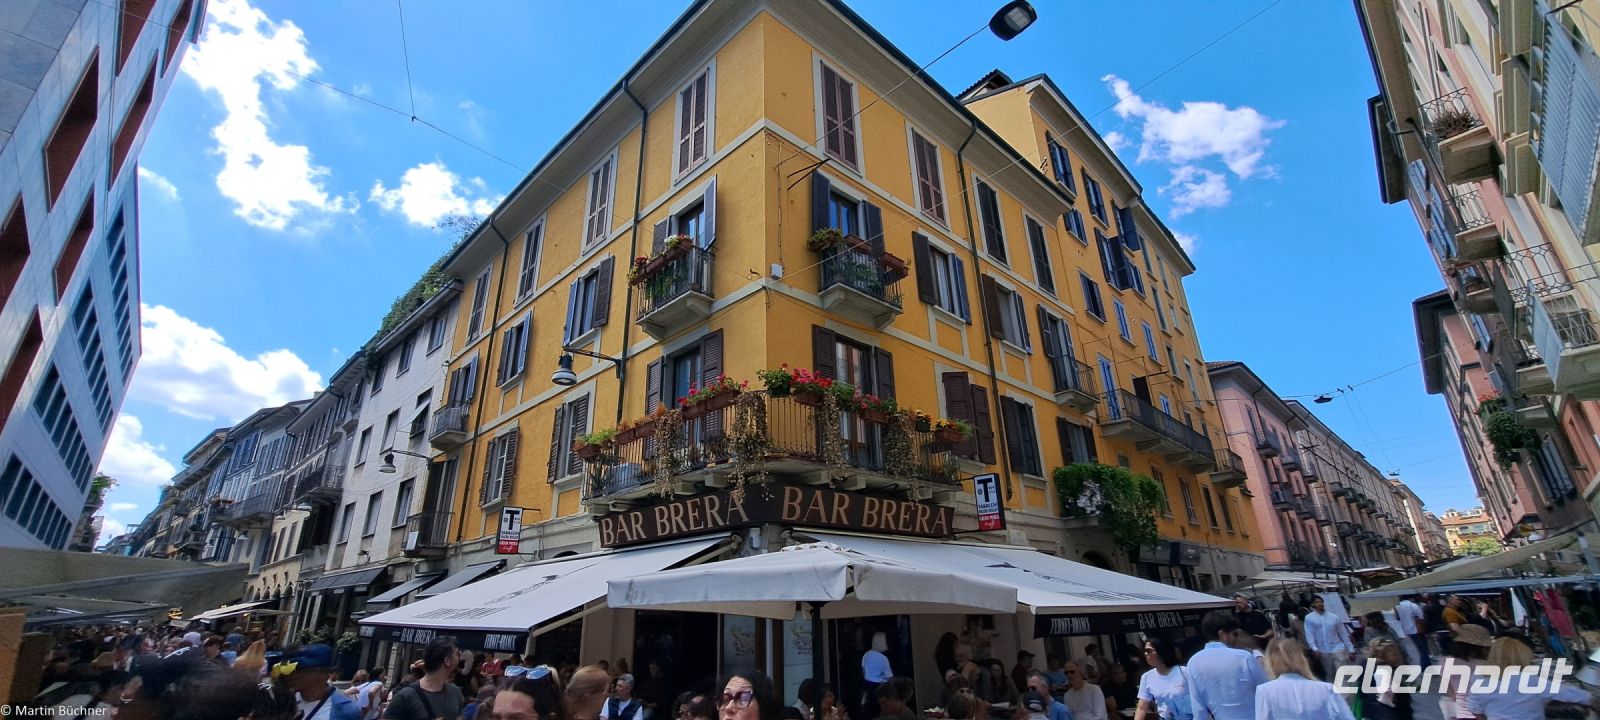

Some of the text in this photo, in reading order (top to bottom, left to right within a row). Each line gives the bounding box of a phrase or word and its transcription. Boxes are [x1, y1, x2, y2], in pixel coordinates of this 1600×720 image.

[977, 478, 992, 502] T
[505, 510, 520, 530] T
[601, 489, 749, 546] BAR BRERA
[782, 486, 948, 535] BAR BRERA
[1138, 613, 1156, 629] BAR
[1157, 612, 1183, 628] BRERA
[401, 628, 413, 643] BAR
